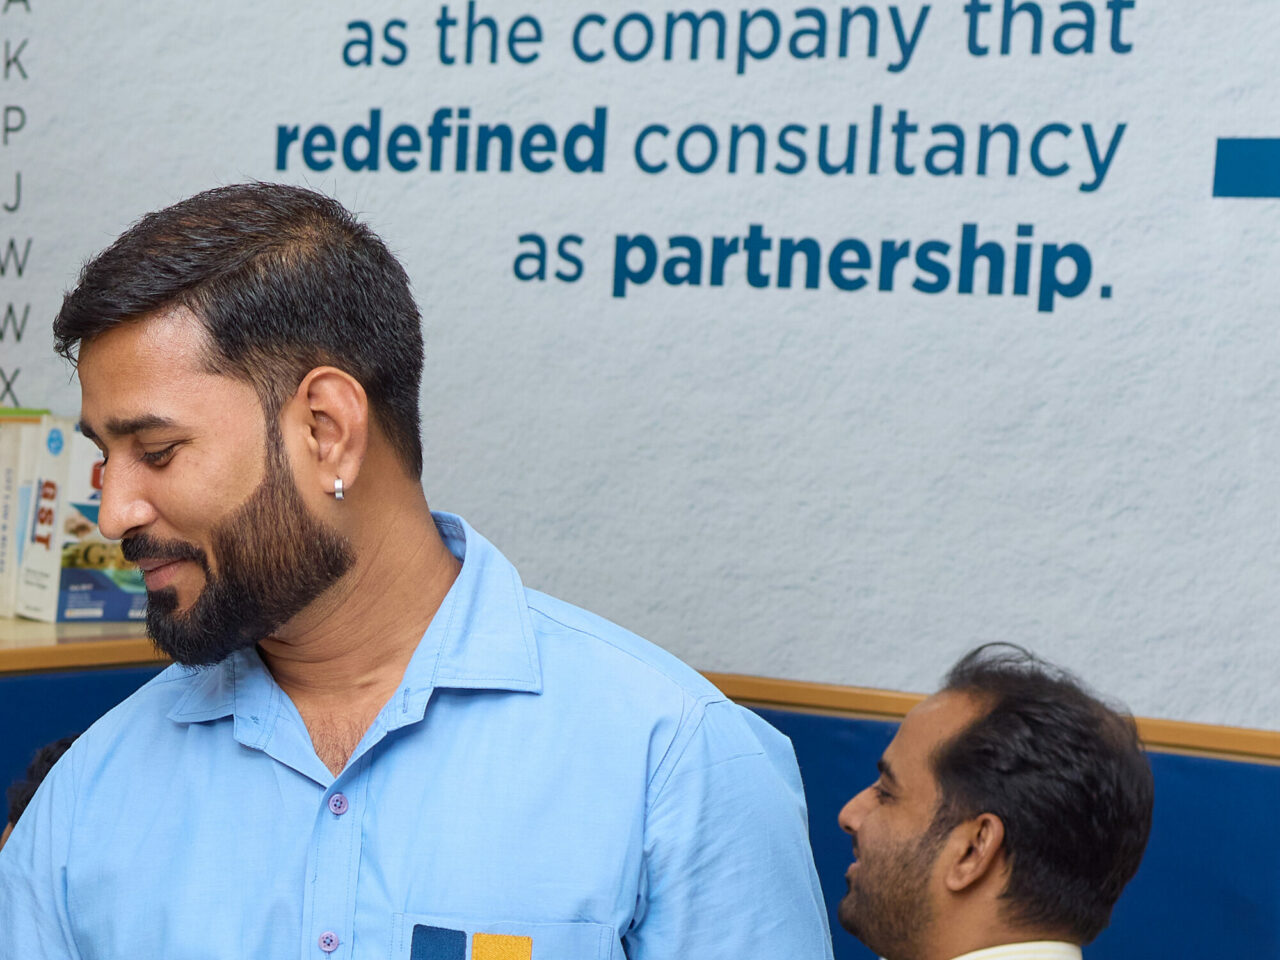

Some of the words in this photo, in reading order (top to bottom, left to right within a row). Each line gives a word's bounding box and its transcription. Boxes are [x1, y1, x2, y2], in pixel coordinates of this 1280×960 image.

[342, 18, 410, 68] as
[435, 0, 546, 67] the
[571, 3, 933, 76] company
[962, 0, 1137, 58] that
[275, 105, 610, 176] redefined
[633, 103, 1129, 194] consultancy
[513, 232, 585, 284] as
[611, 222, 1114, 314] partnership.
[34, 480, 58, 552] GST
